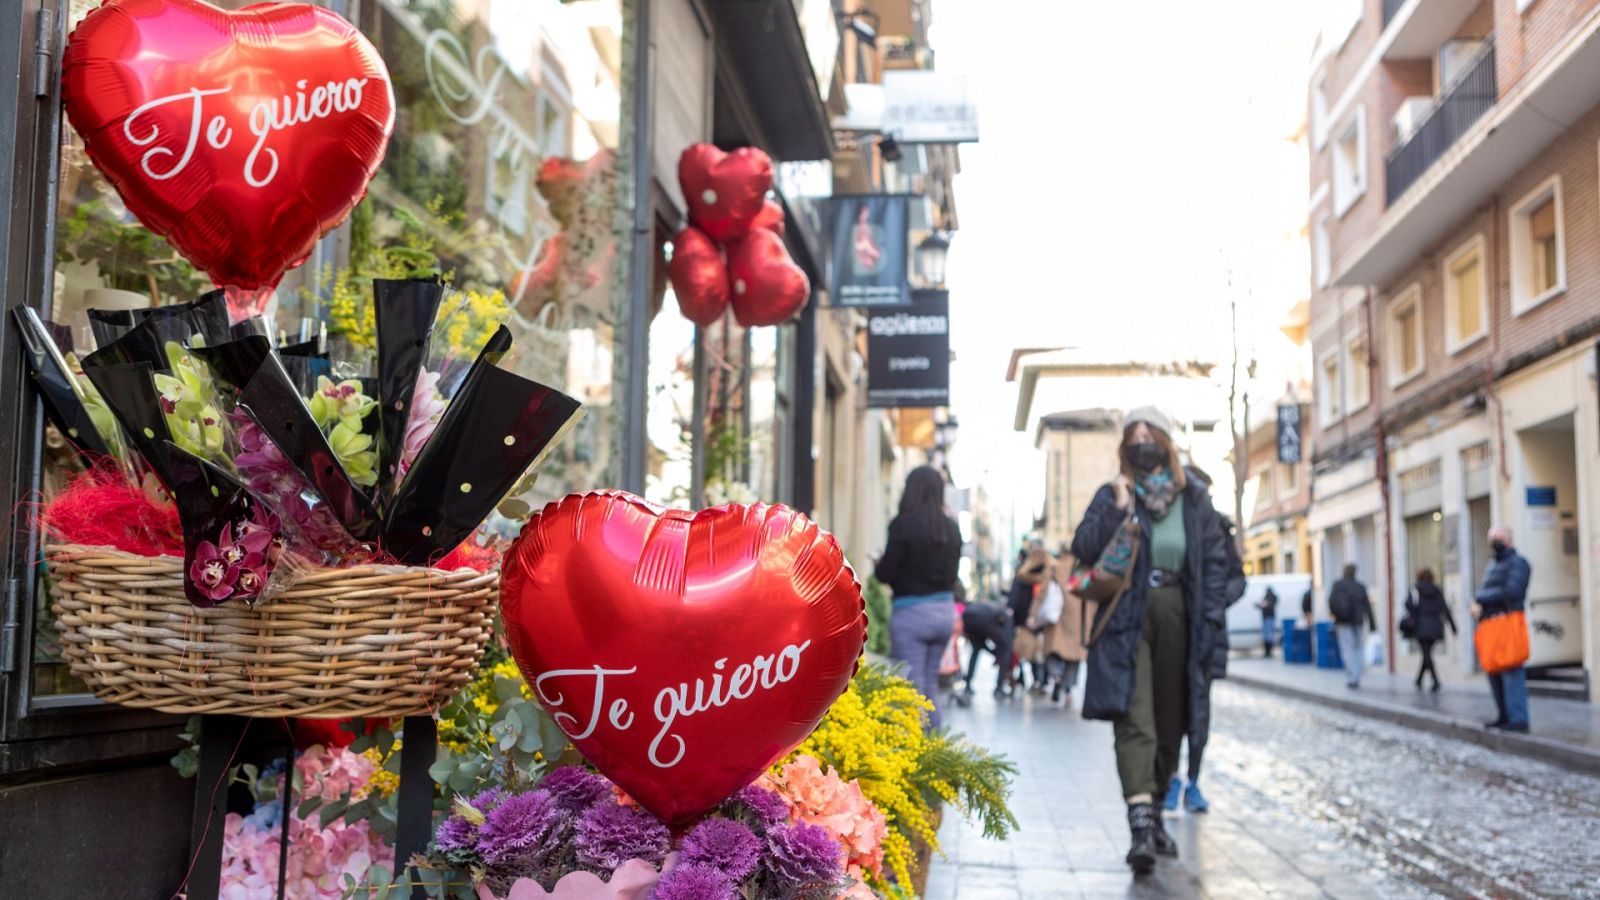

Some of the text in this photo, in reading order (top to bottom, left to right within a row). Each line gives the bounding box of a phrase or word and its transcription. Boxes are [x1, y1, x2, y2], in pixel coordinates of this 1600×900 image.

[123, 77, 368, 188] Te quiero
[536, 639, 811, 768] Te quiero
